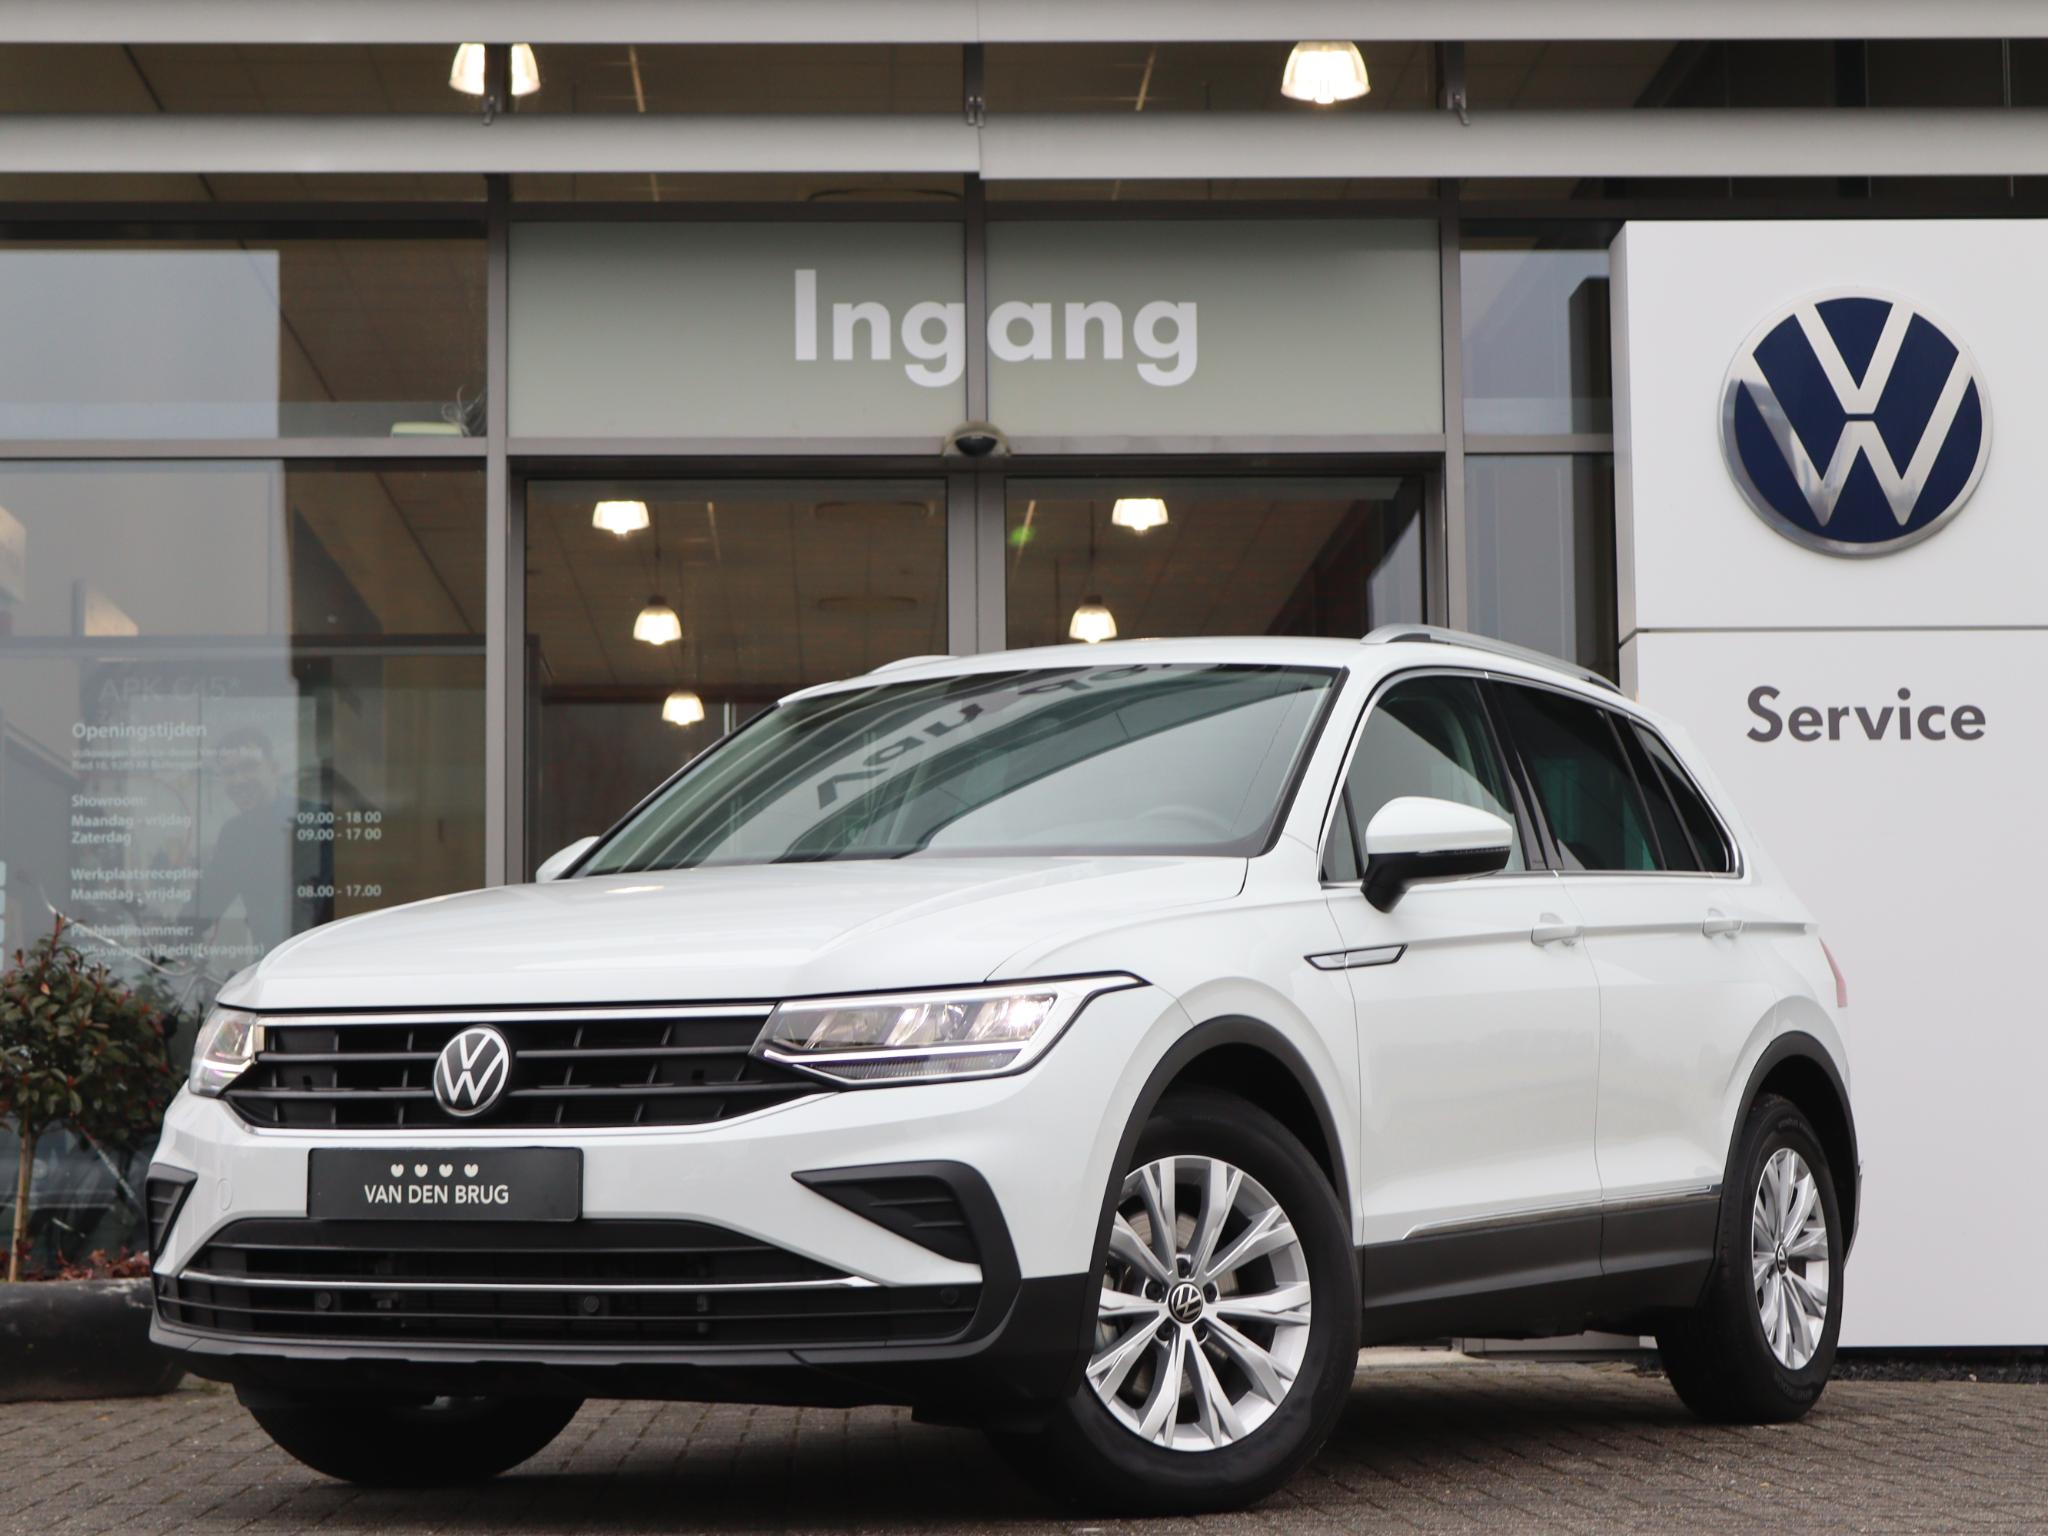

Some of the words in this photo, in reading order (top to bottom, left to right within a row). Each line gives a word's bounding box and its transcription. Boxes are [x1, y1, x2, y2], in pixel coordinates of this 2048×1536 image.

[795, 269, 1198, 388] Ingang
[1726, 290, 1984, 540] VW
[1746, 685, 1986, 743] Service
[71, 722, 207, 742] Openingstijden
[71, 793, 147, 808] Showroom:
[71, 813, 134, 829] Maandag
[144, 813, 191, 829] vrijdag
[297, 811, 335, 825] 09.00
[71, 830, 131, 847] Zaterdag
[297, 828, 335, 842] 09.00
[70, 867, 204, 883] Werkplaatsreceptie:
[71, 888, 134, 904] Maandag
[144, 888, 191, 904] vrijdag
[297, 884, 335, 898] 08.00
[346, 884, 382, 898] 17.00
[436, 1029, 509, 1113] VW
[363, 1184, 402, 1204] VAN
[408, 1184, 449, 1204] DEN
[455, 1184, 509, 1205] BRUG
